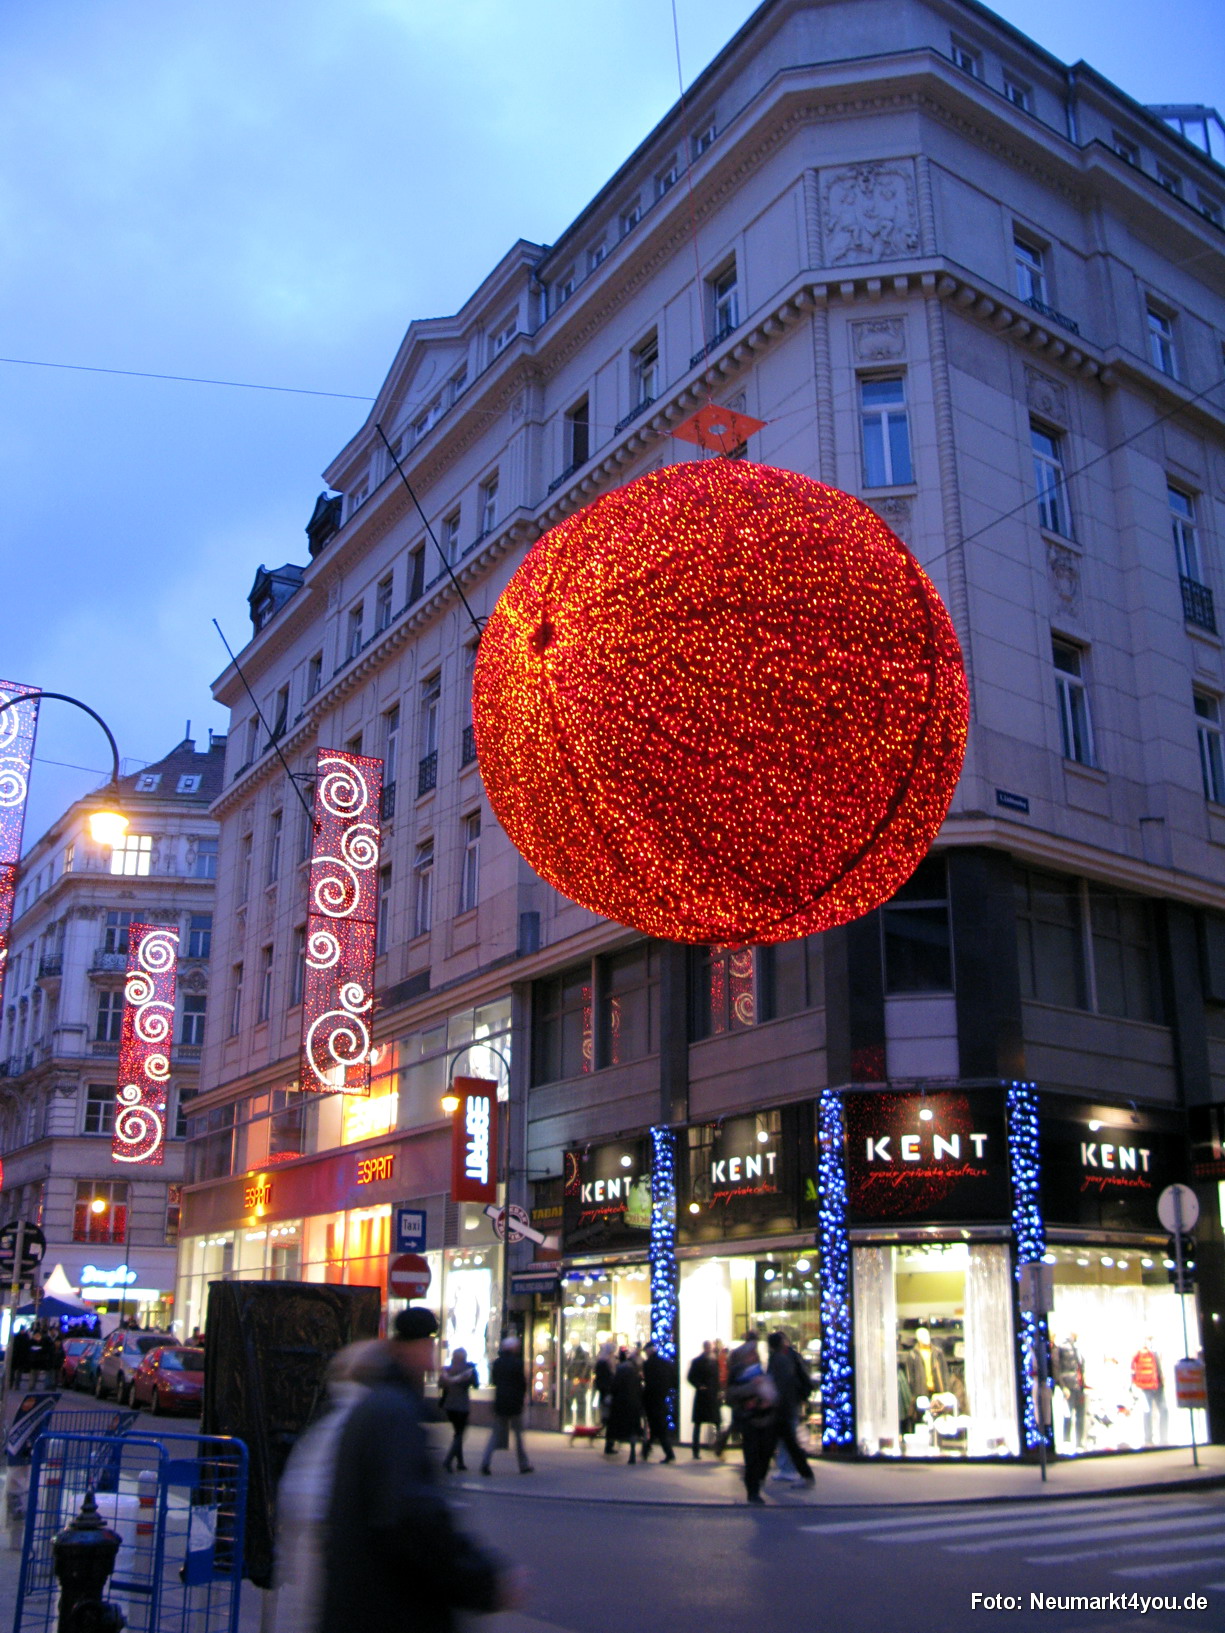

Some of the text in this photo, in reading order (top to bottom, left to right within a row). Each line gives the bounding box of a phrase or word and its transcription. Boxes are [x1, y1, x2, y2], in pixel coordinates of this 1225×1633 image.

[464, 1095, 490, 1185] ESPRIT
[865, 1132, 988, 1162] KENT
[356, 1154, 396, 1185] ESPRIT
[711, 1151, 777, 1184] KENT
[1080, 1142, 1150, 1173] KENT
[581, 1176, 632, 1204] KENT
[860, 1169, 899, 1190] your
[891, 1165, 944, 1188] private
[244, 1184, 272, 1208] ESPRIT
[403, 1218, 421, 1232] Taxi
